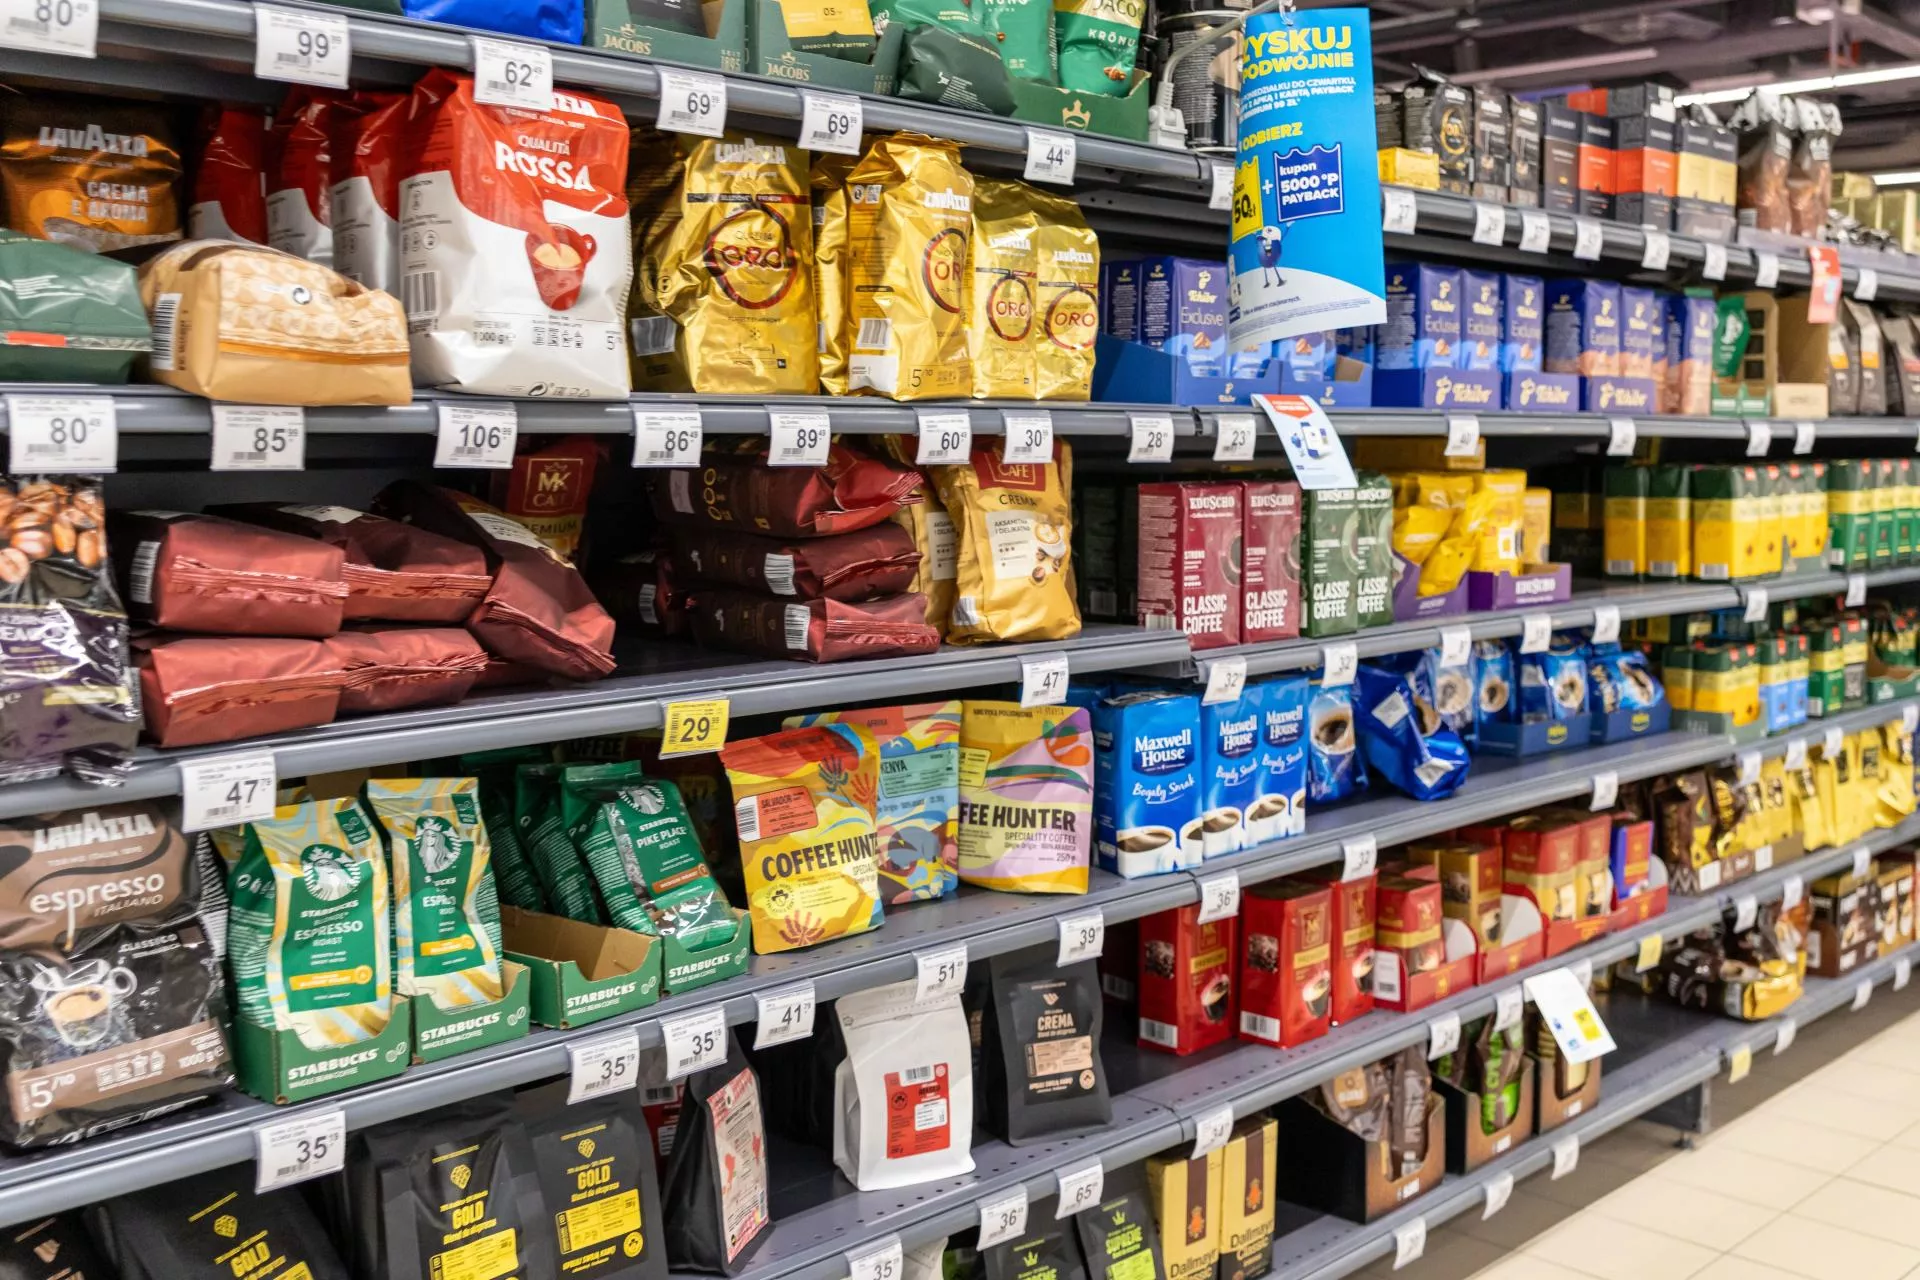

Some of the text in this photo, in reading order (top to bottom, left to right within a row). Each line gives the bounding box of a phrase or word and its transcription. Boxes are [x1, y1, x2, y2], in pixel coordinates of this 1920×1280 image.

[34, 0, 74, 26] 80
[297, 30, 330, 59] 99
[602, 34, 651, 55] JACOBS
[504, 60, 533, 88] 62
[766, 62, 811, 82] JACOBS
[687, 92, 711, 117] 69
[827, 112, 851, 137] 69
[39, 123, 149, 158] LAVAZZA
[1242, 121, 1304, 151] ODBIERZ
[494, 139, 597, 193] ROSSA
[1046, 147, 1064, 167] 44
[1280, 162, 1317, 176] kupon
[86, 181, 149, 203] CREMA
[1281, 176, 1320, 194] 5000
[1282, 187, 1340, 206] PAYBACK
[87, 204, 149, 223] AROMA
[720, 244, 785, 271] ORO
[934, 260, 962, 282] OR
[995, 300, 1029, 320] ORO
[1054, 312, 1096, 328] ORO
[1181, 306, 1225, 327] Exclusive
[50, 418, 88, 445] 80
[254, 428, 287, 452] 85
[460, 424, 501, 449] 106
[665, 430, 689, 451] 86
[796, 428, 818, 449] 89
[941, 431, 960, 450] 60
[1025, 429, 1042, 448] 30
[1148, 431, 1162, 448] 28
[1232, 430, 1246, 447] 23
[999, 493, 1038, 507] CREMA
[1189, 494, 1235, 510] EDUSCHO
[1251, 493, 1295, 508] EDUSCHO
[1245, 589, 1288, 611] CLASSIC
[1313, 580, 1350, 600] CLASSIC
[1183, 594, 1227, 616] CLASSIC
[1313, 600, 1347, 619] COFFEE
[1183, 614, 1223, 635] COFFEE
[1245, 608, 1286, 630] COFFEE
[1043, 671, 1059, 690] 47
[1225, 673, 1237, 688] 32
[1219, 715, 1258, 734] Maxwell
[1266, 705, 1304, 726] Maxwell
[680, 715, 711, 743] 29
[1270, 723, 1299, 740] House
[1135, 729, 1192, 753] Maxwell
[1223, 732, 1253, 751] House
[1141, 748, 1185, 768] House
[226, 779, 259, 805] 47
[992, 805, 1077, 833] HUNTER
[32, 812, 157, 854] LAVAZZA
[636, 833, 660, 849] PIKE
[1004, 831, 1077, 845] SPECIALITY COFFEE
[761, 841, 838, 882] COFFEE
[29, 873, 165, 922] espresso
[93, 893, 164, 918] ITALIANO
[1217, 891, 1231, 909] 36
[294, 920, 364, 941] ESPRESSO
[1079, 928, 1096, 948] 39
[668, 955, 731, 978] STARBUCKS
[938, 962, 955, 984] 51
[566, 982, 638, 1008] STARBUCKS
[780, 1004, 803, 1025] 41
[1037, 1012, 1074, 1032] CREMA
[420, 1011, 503, 1042] STARBUCKS
[691, 1032, 715, 1056] 35
[287, 1048, 381, 1080] STARBUCKS
[601, 1056, 626, 1080] 35
[296, 1135, 328, 1163] 35
[577, 1164, 611, 1191] GOLD
[1075, 1183, 1093, 1204] 65
[452, 1200, 485, 1230] GOLD
[1001, 1208, 1018, 1230] 36
[1231, 1217, 1275, 1249] Dallmayr
[230, 1241, 271, 1278] GOLD
[873, 1260, 893, 1280] 35
[1170, 1249, 1219, 1278] Dallmayr
